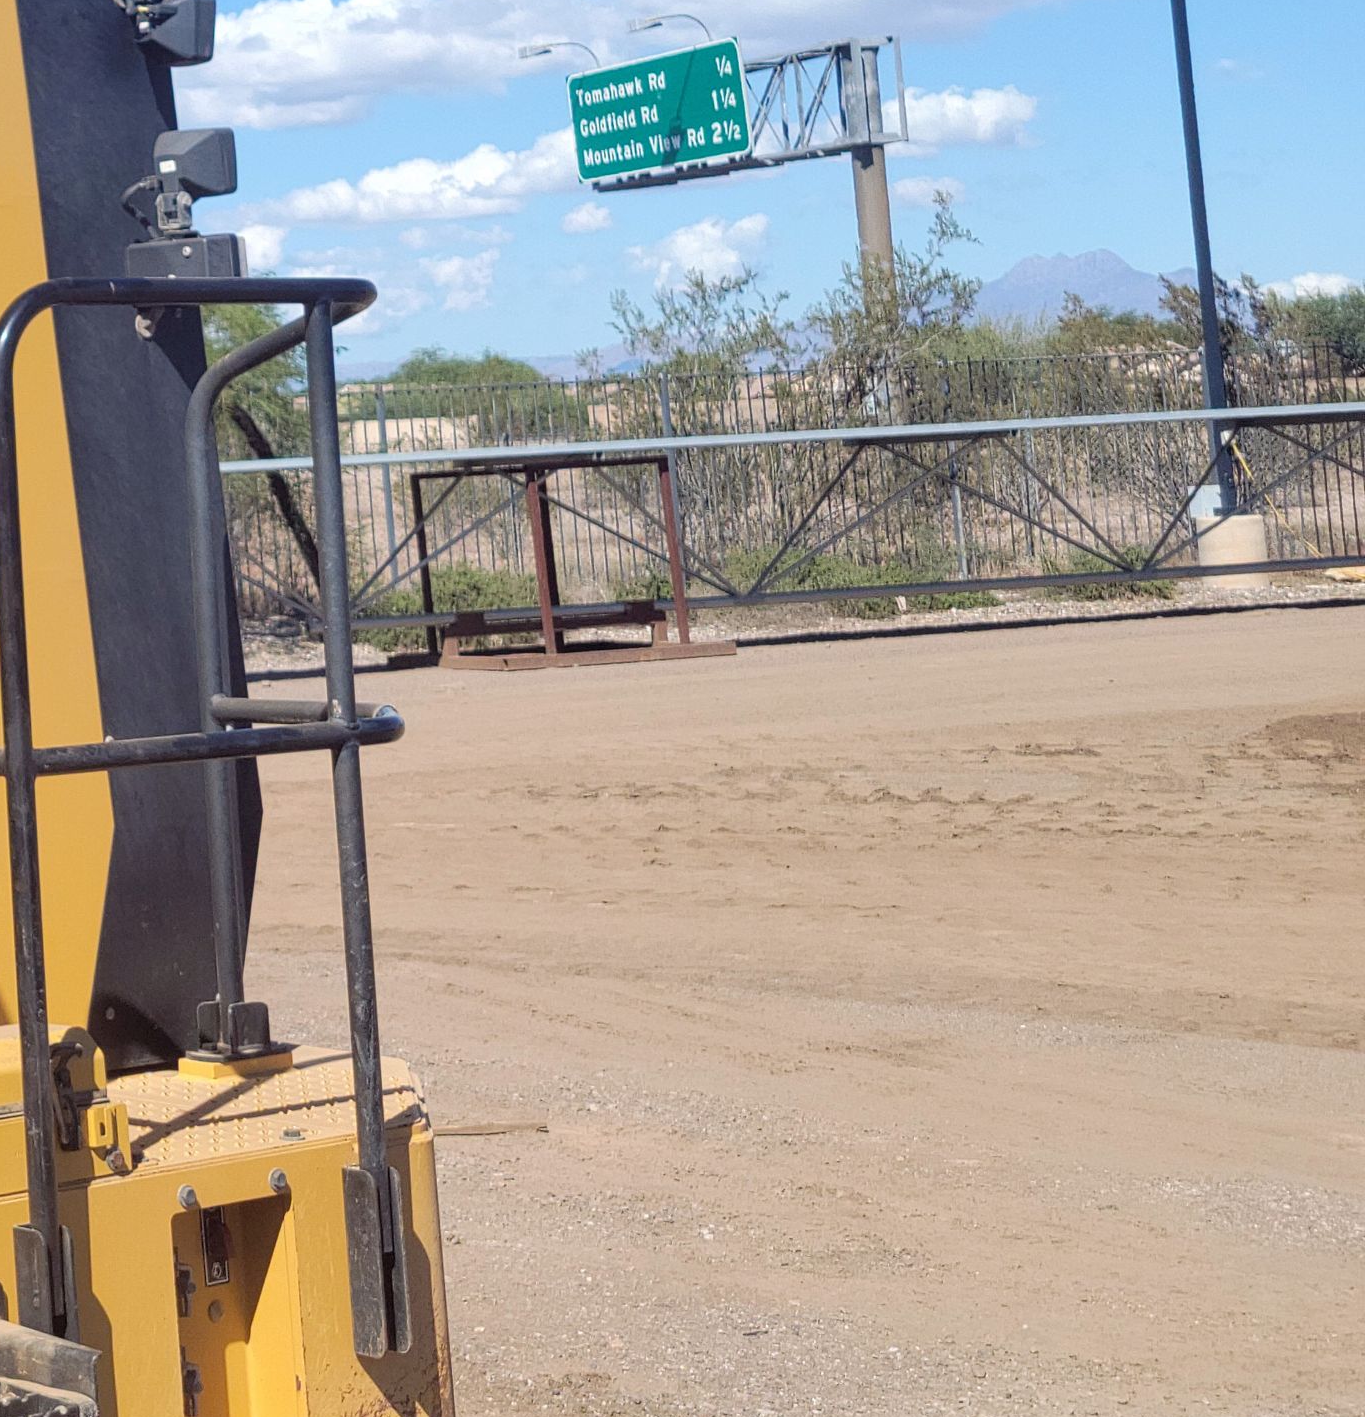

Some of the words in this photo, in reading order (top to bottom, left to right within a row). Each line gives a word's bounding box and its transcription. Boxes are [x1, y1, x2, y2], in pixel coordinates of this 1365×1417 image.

[576, 77, 643, 107] Tomahawk
[648, 72, 666, 92] Rd
[580, 109, 637, 138] Goldfield
[641, 105, 658, 125] Rd
[583, 139, 645, 167] Mountain
[649, 133, 681, 155] View
[686, 126, 706, 148] Rd
